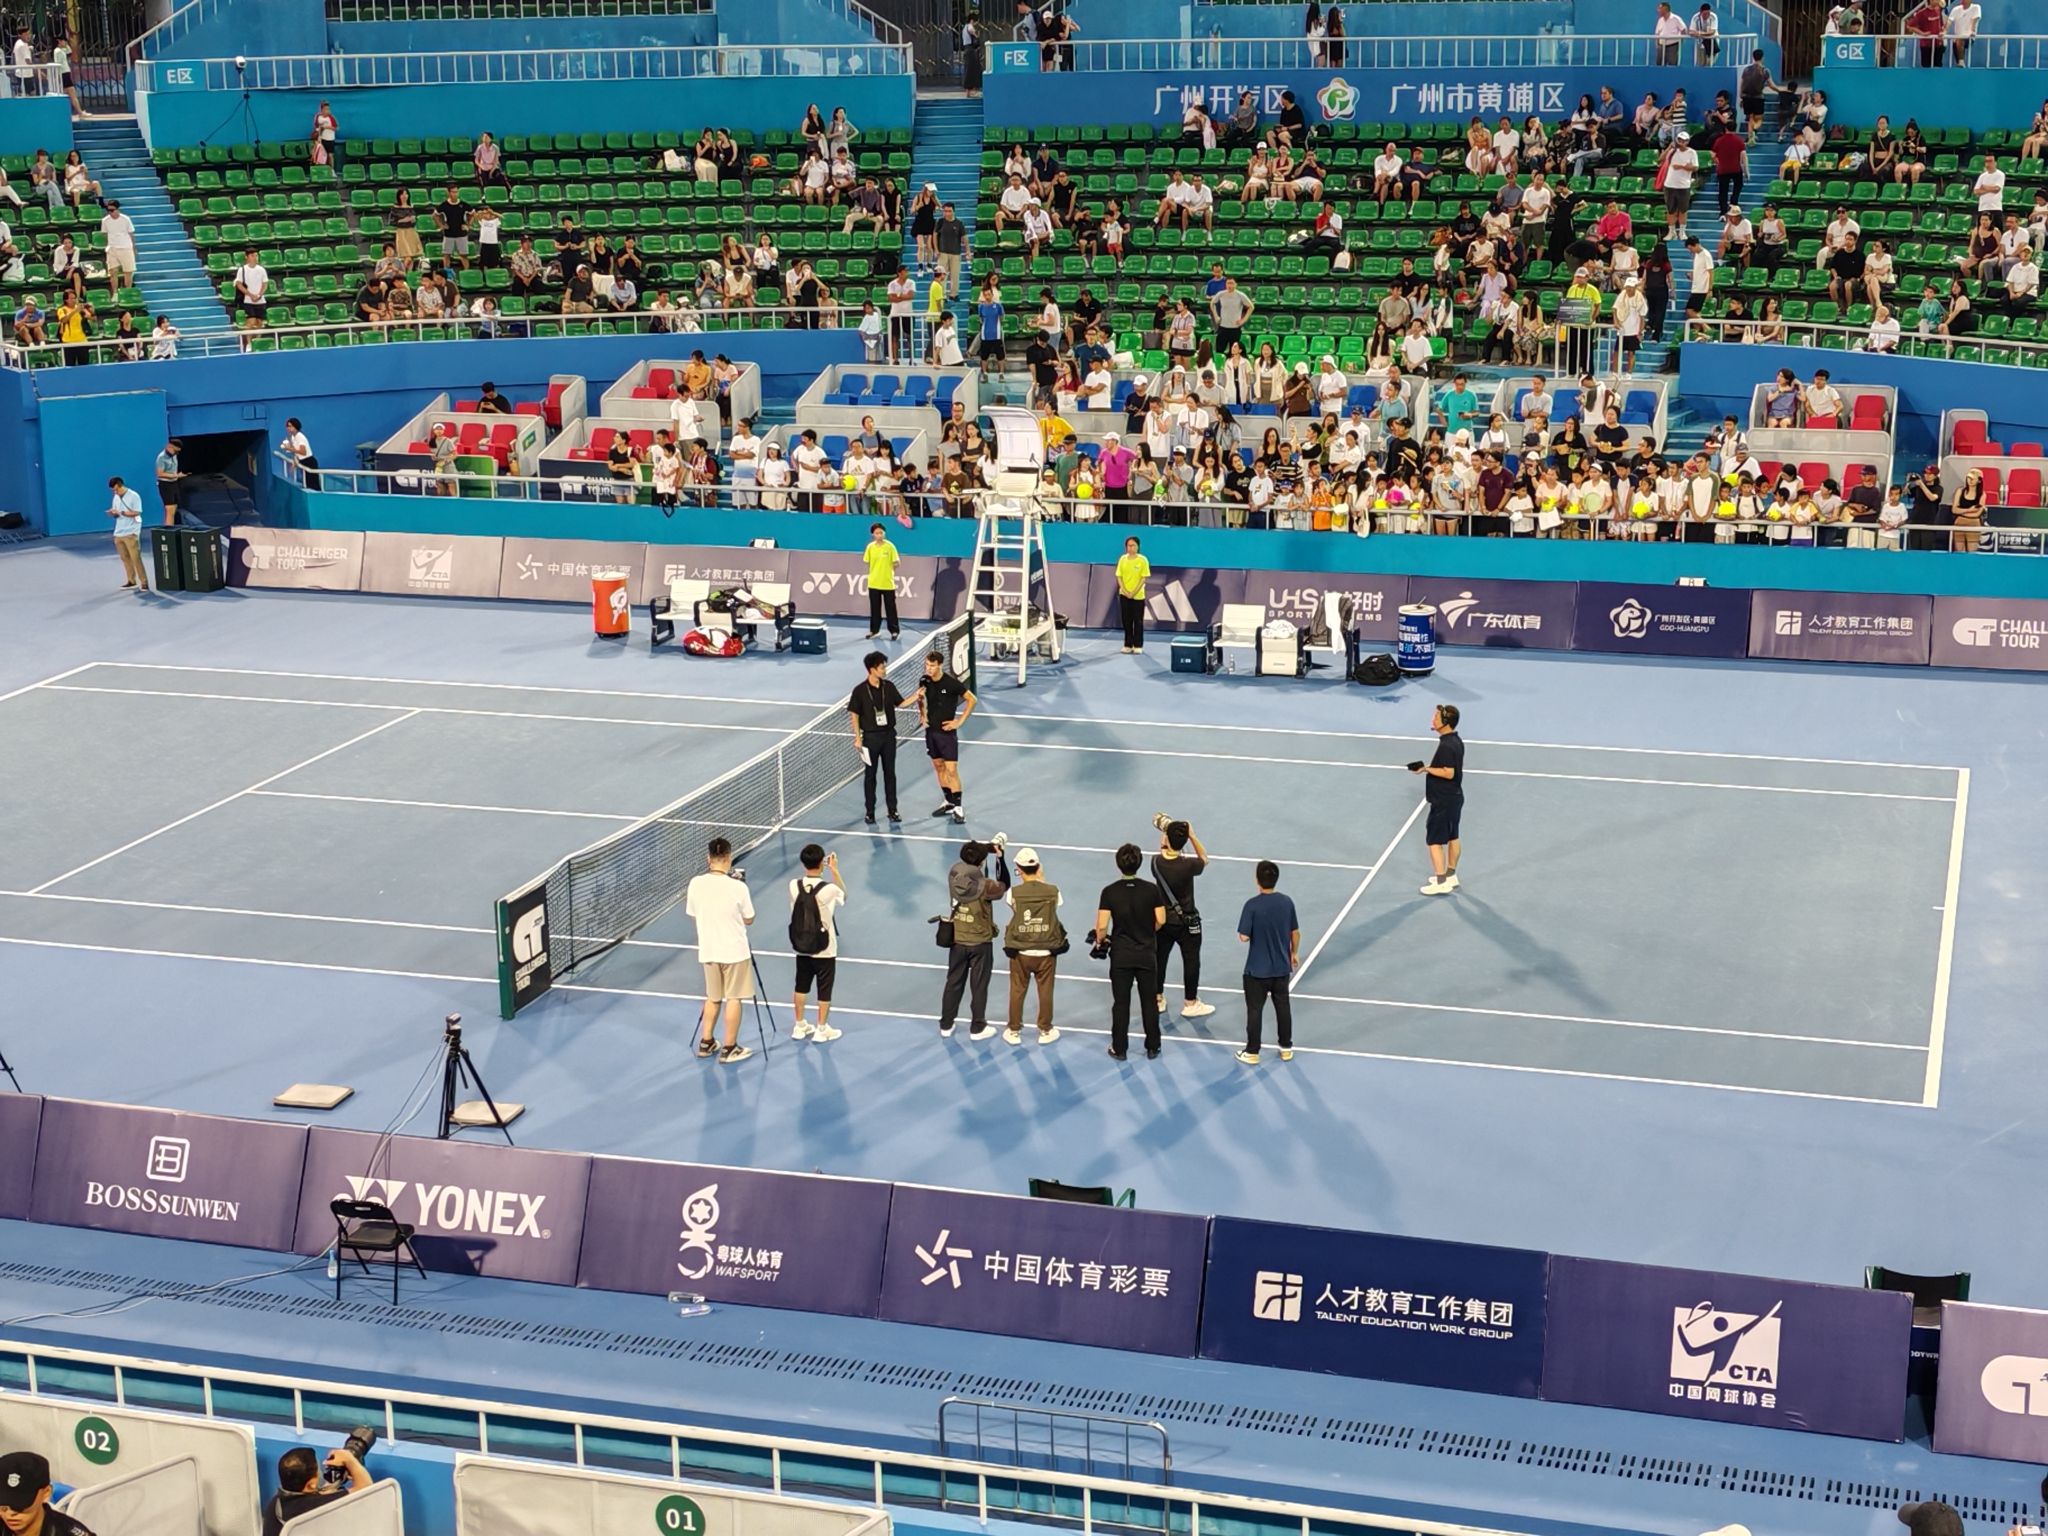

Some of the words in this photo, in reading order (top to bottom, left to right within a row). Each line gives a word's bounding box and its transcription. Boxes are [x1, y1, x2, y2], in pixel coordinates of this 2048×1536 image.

[1004, 49, 1030, 66] F区
[1836, 42, 1865, 60] G区
[167, 67, 195, 84] E区
[1389, 82, 1565, 113] 广州市黄埔区
[276, 546, 348, 560] CHALLENGER
[277, 557, 306, 570] TOUR
[690, 567, 775, 582] 人才教育工作集团
[1467, 612, 1541, 630] 广东体育
[1808, 614, 1913, 630] 人才教育工作集团
[2000, 634, 2040, 649] TOUR
[415, 1182, 547, 1239] YONEX
[717, 1244, 783, 1270] 粤球人体育
[715, 1265, 780, 1282] WAFSPORT
[984, 1250, 1171, 1297] 中国体育彩票
[1315, 1282, 1513, 1327] 人才教育工作集团
[1315, 1310, 1359, 1324] TALENT
[1360, 1315, 1427, 1331] EDUCATION
[1429, 1323, 1466, 1335] WORK
[1468, 1327, 1514, 1341] GROUP
[1728, 1364, 1773, 1384] CTA
[1669, 1383, 1776, 1408] 中国网球协会
[83, 1429, 112, 1452] 02
[666, 1508, 697, 1531] 01
